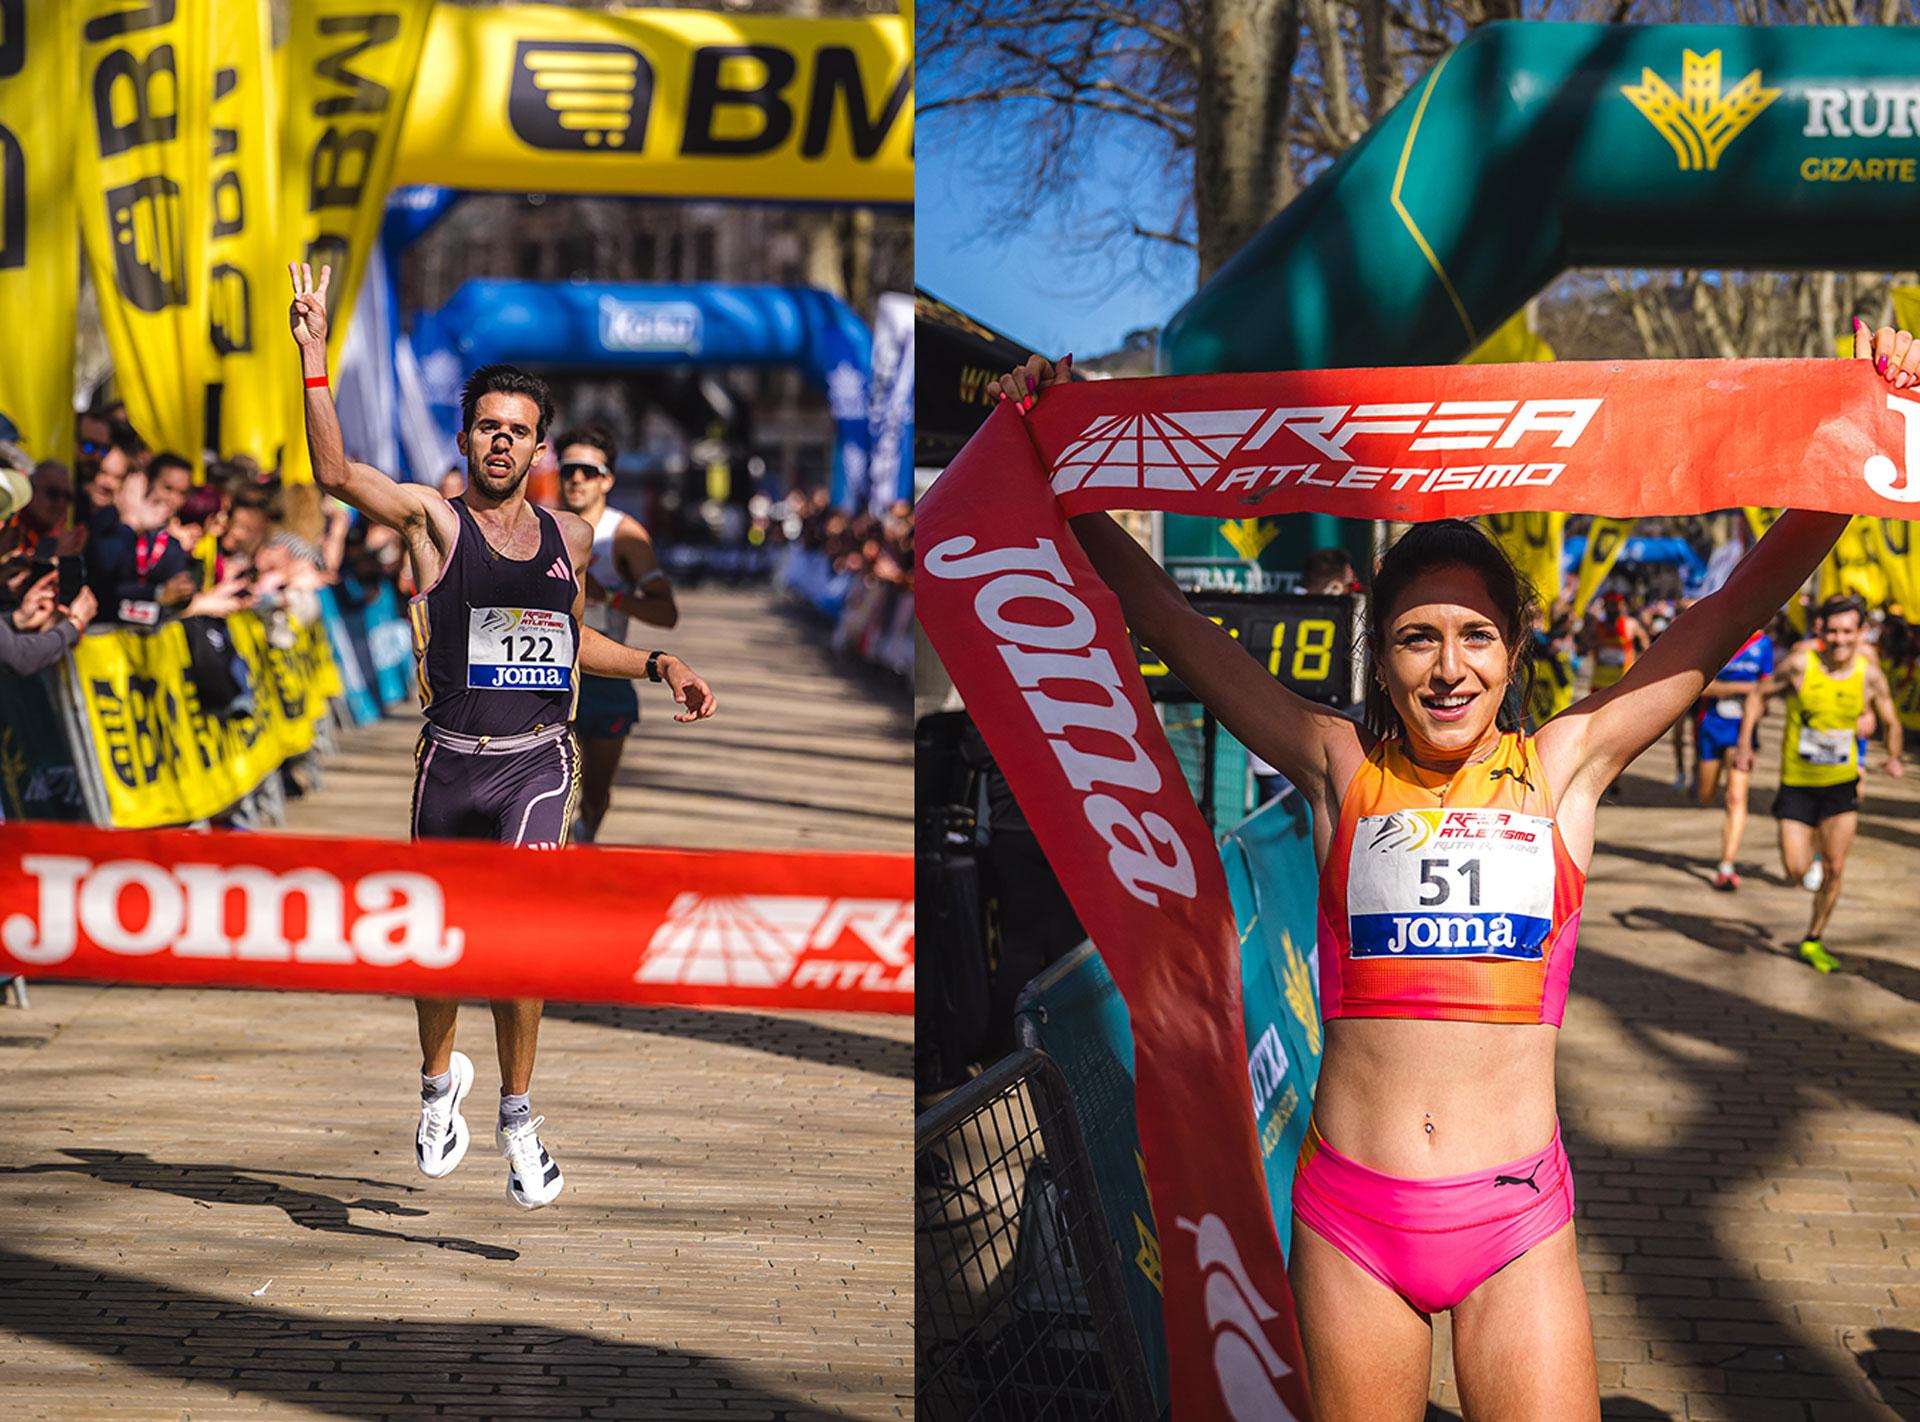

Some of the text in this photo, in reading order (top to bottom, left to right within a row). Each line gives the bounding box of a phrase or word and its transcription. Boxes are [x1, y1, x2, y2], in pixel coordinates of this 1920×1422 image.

[1800, 157, 1917, 182] GIZARTE
[1241, 398, 1604, 462] RFEA
[1215, 462, 1567, 493] ATLETISMO
[500, 635, 555, 663] 122
[491, 666, 562, 687] Joma
[924, 535, 1197, 907] Joma
[1439, 827, 1536, 843] ATLETISMO
[1419, 858, 1481, 907] 51
[2, 854, 465, 969] Joma
[1387, 913, 1516, 953] Joma
